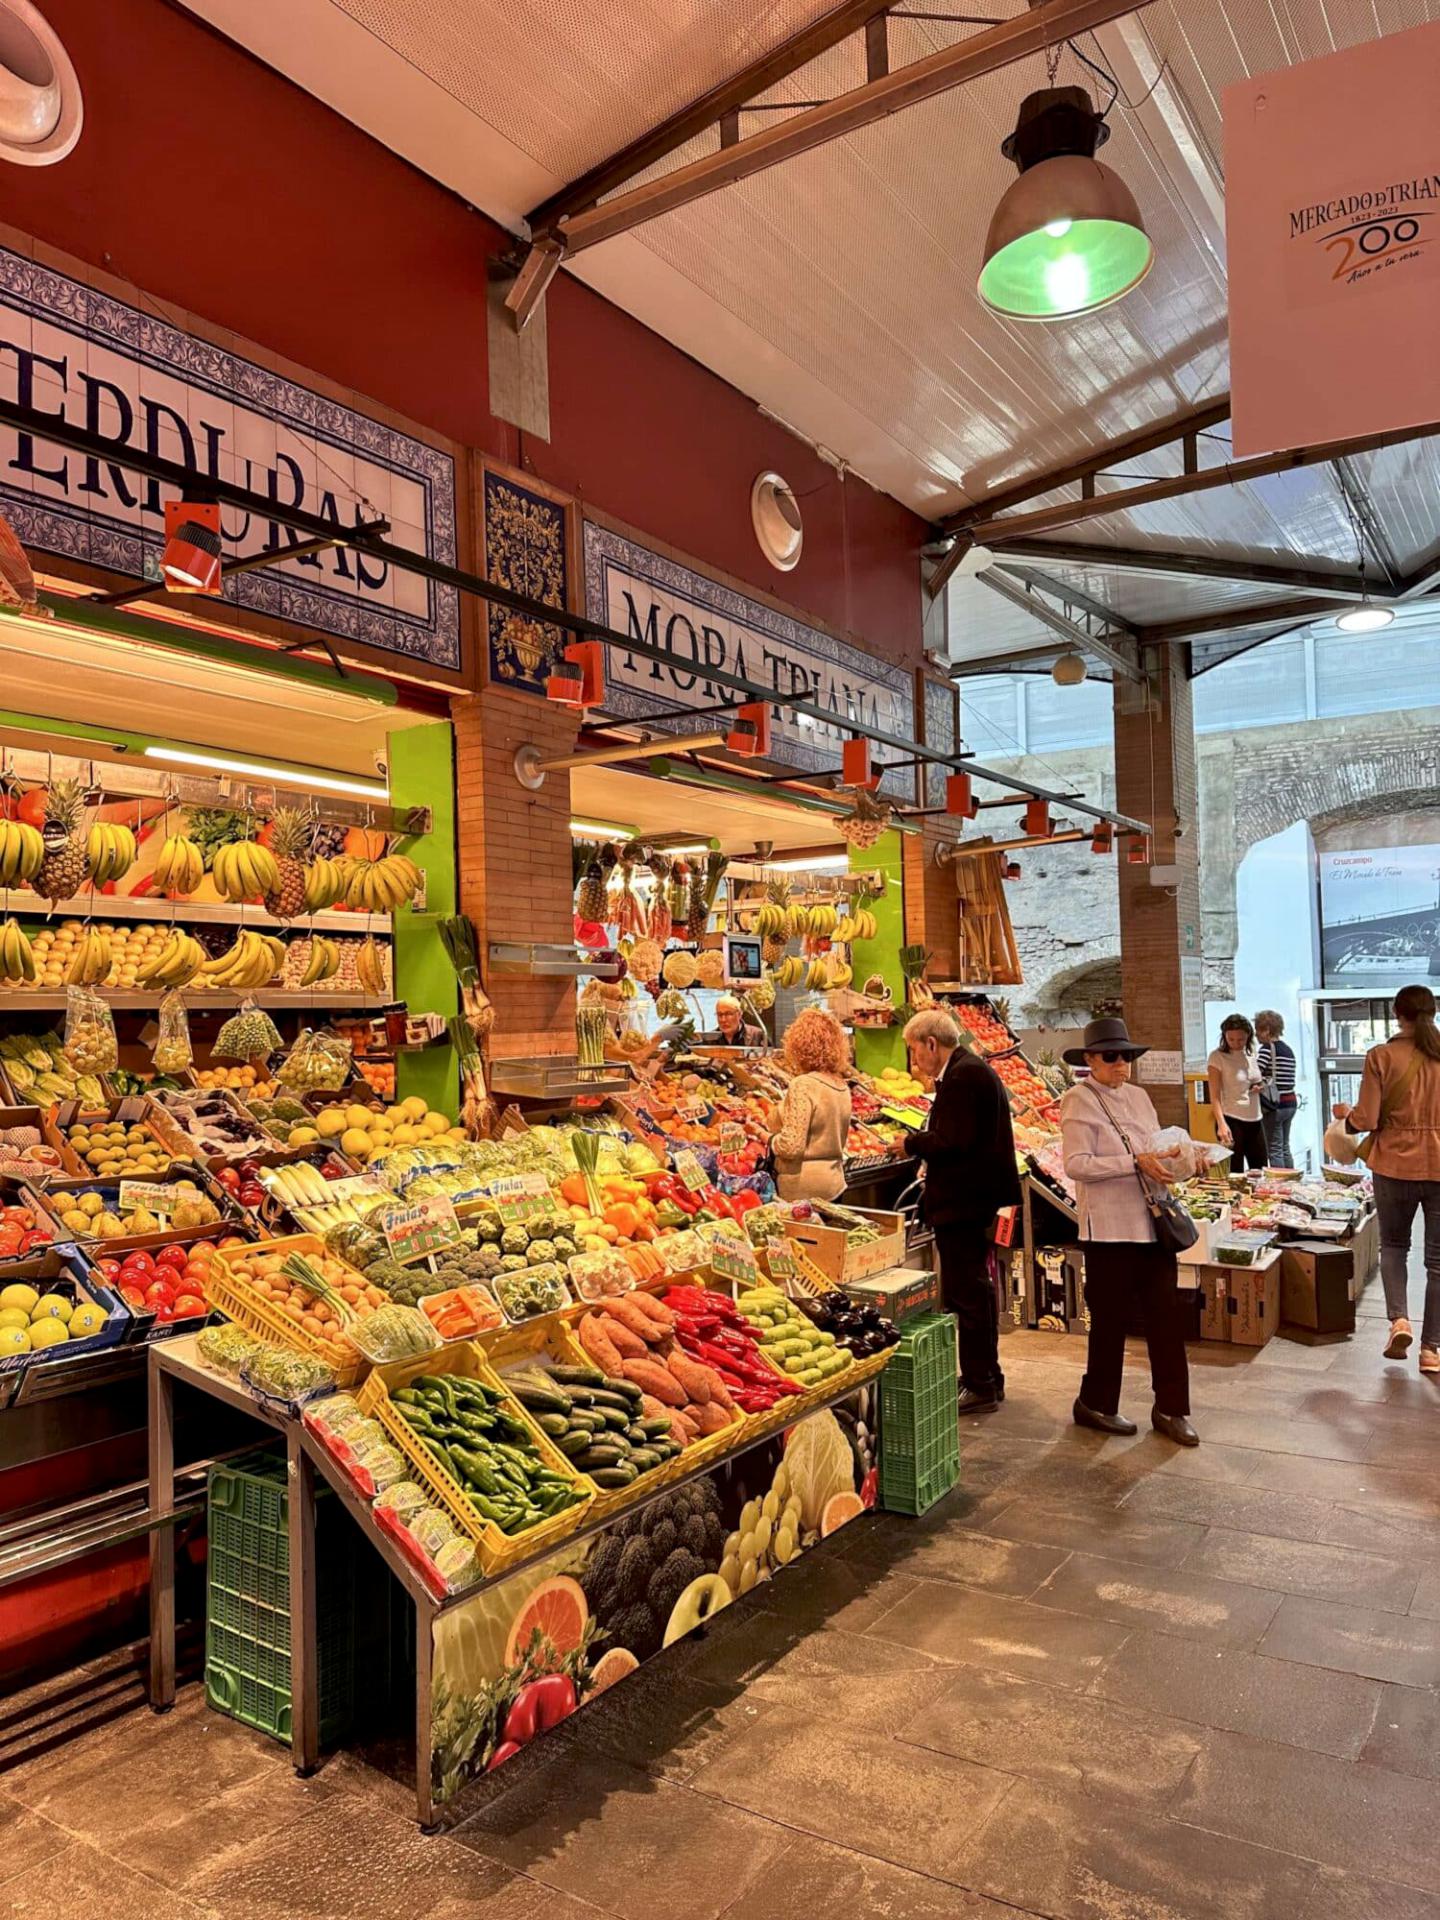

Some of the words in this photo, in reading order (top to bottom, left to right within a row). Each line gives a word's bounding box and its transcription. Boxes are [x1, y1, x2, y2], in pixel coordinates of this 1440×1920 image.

[1289, 192, 1373, 239] MERCADO
[1326, 218, 1420, 281] 200
[0, 340, 390, 591] ERDURAS
[622, 590, 753, 706] MORA
[762, 644, 888, 758] TRIANA
[491, 1178, 523, 1196] Frutas
[384, 1203, 422, 1231] Frutas
[145, 1327, 173, 1340] KANZI
